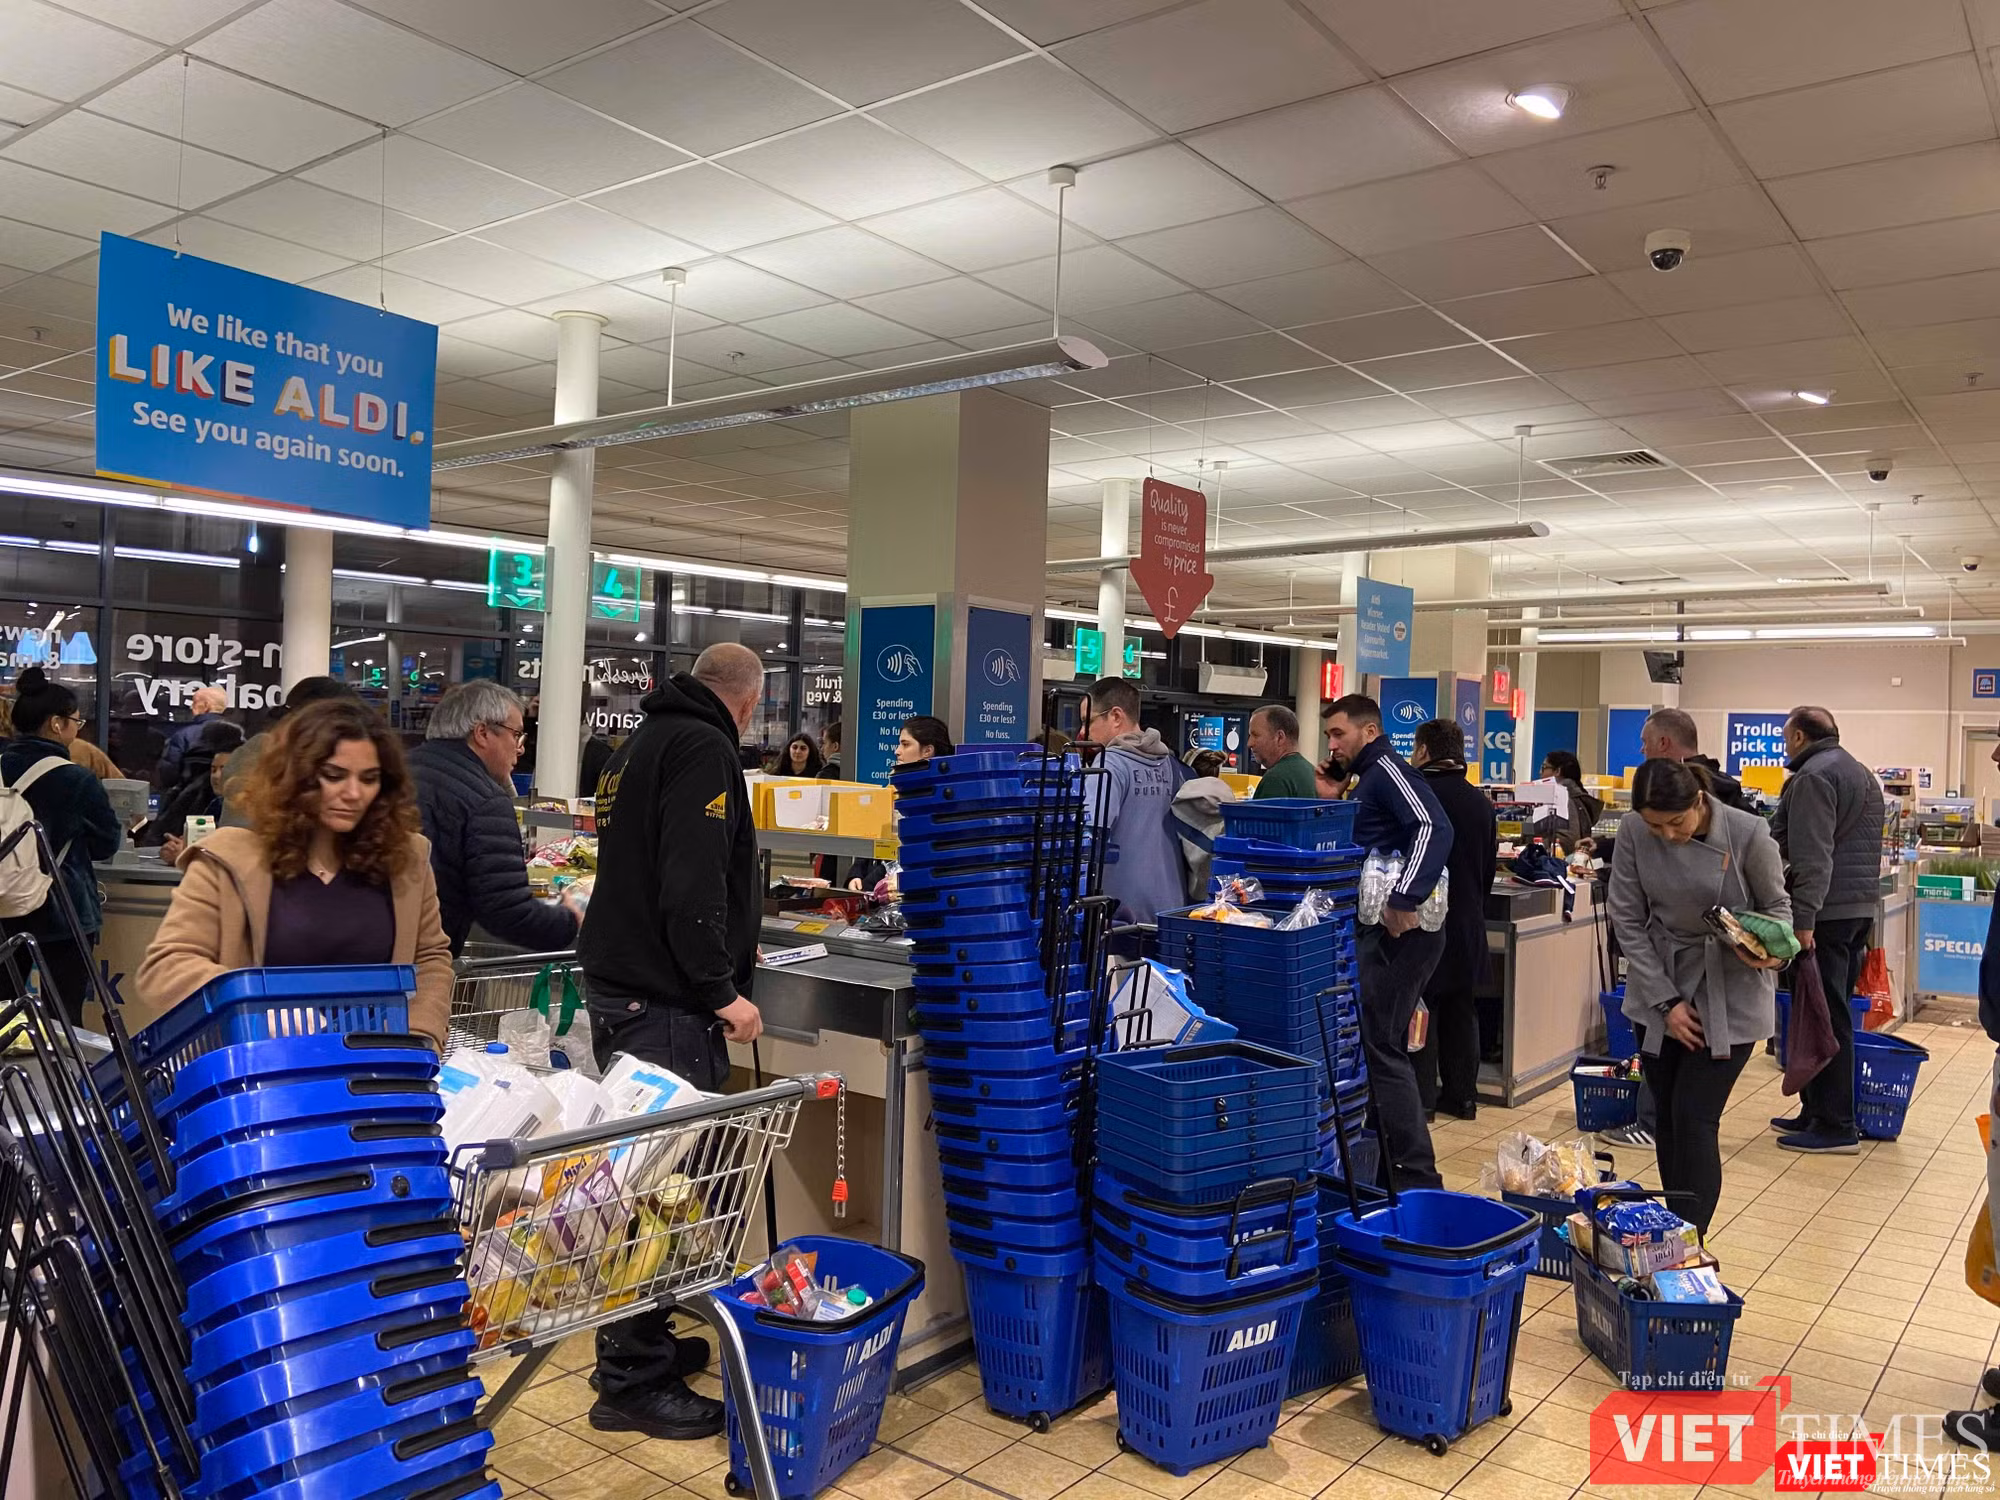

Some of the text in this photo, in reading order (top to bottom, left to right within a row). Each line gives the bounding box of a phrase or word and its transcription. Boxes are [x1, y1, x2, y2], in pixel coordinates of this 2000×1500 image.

[167, 303, 383, 378] We like that you
[109, 334, 424, 444] LIKE ALDI.
[133, 402, 404, 477] See you again soon.
[1150, 489, 1189, 523] Quality
[1161, 519, 1188, 536] is never
[1154, 534, 1200, 554] compromised
[512, 555, 533, 586] 3
[1163, 553, 1197, 575] by price
[603, 567, 624, 599] 4
[1163, 586, 1179, 623] £
[1087, 638, 1097, 659] 5
[1125, 644, 1135, 664] 6
[371, 668, 381, 680] 5
[410, 671, 418, 681] 6
[876, 697, 914, 710] Spending
[982, 700, 1013, 714] Spending
[872, 711, 887, 720] £30
[888, 712, 897, 720] or
[979, 714, 1016, 724] £30 or less?
[879, 727, 890, 736] No
[985, 730, 1011, 739] No fuss.
[1200, 727, 1221, 736] LIKE
[1733, 722, 1784, 737] Trolle
[878, 743, 890, 751] No
[1731, 737, 1768, 755] pick
[1924, 938, 1984, 955] SPECIA
[857, 1319, 896, 1365] ALDI
[1226, 1319, 1277, 1352] ALDI
